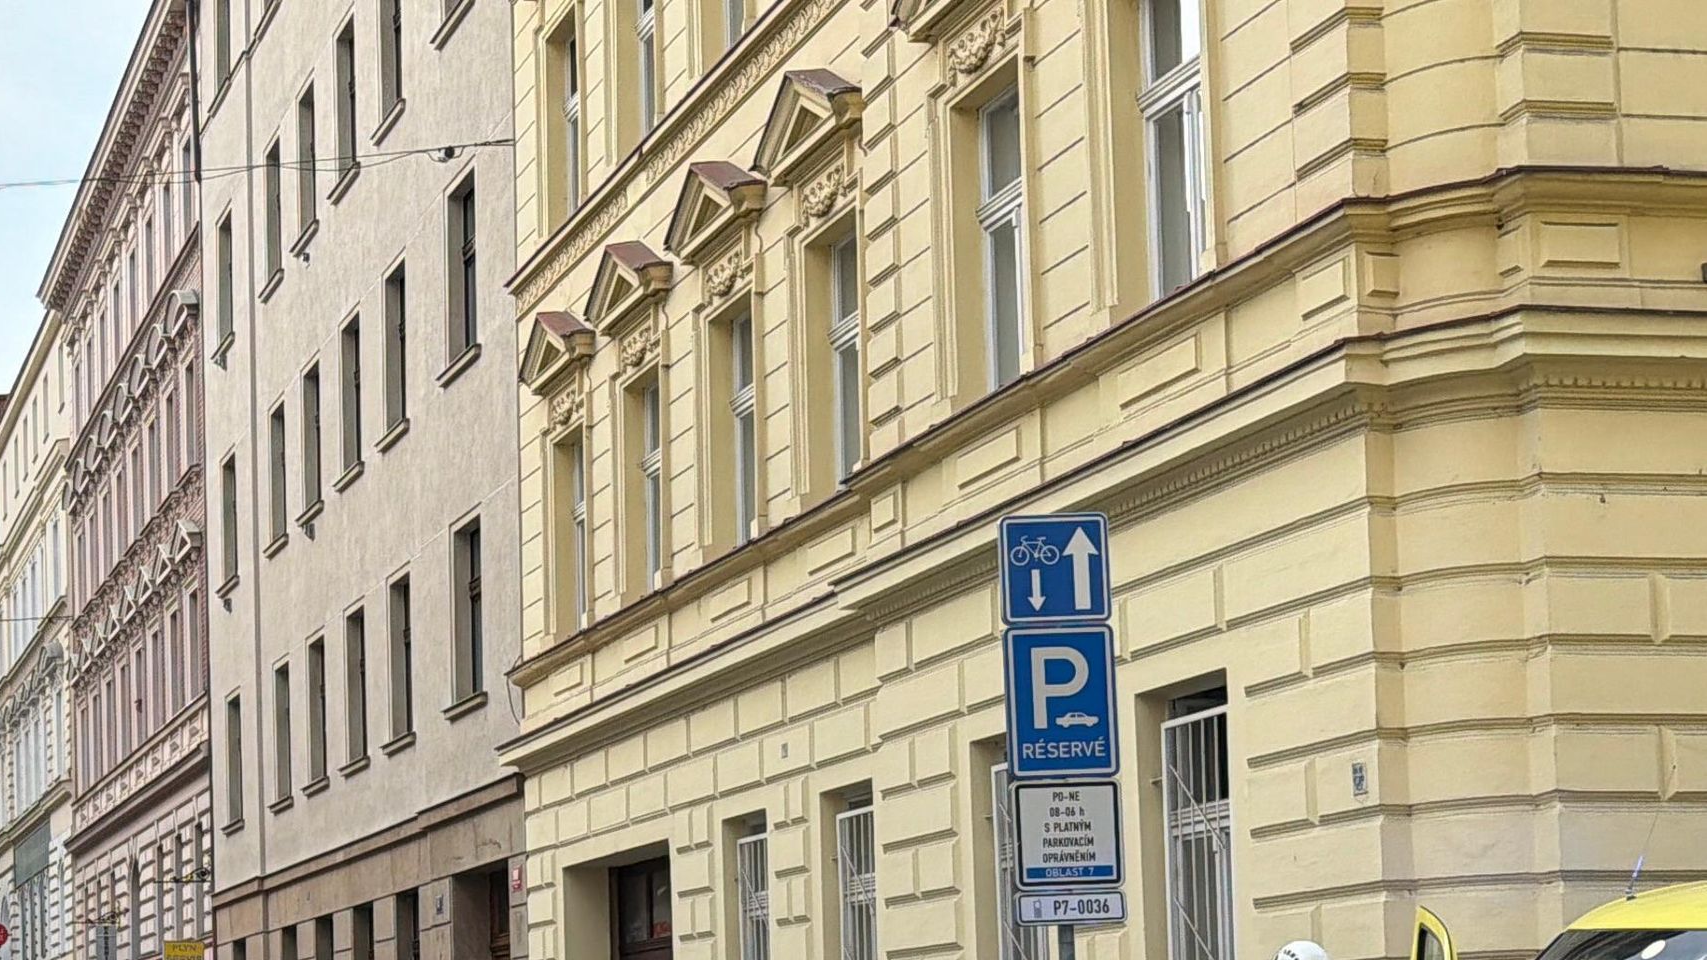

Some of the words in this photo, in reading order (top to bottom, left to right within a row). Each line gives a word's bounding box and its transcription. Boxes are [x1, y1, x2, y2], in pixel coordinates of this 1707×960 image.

[1031, 646, 1089, 729] P
[1022, 736, 1106, 759] RÉSERVÉ
[1052, 791, 1080, 801] PO-NE
[1049, 807, 1076, 817] 08-06
[1079, 806, 1085, 816] h
[1044, 822, 1050, 833] S
[1053, 819, 1091, 832] PLATNÝM
[1042, 835, 1095, 848] PARKOVACÍM
[1042, 849, 1096, 863] OPRÁVNĚNÍM
[1045, 867, 1084, 878] OBLAST
[1088, 867, 1094, 876] 7
[1053, 898, 1110, 915] P7-0036
